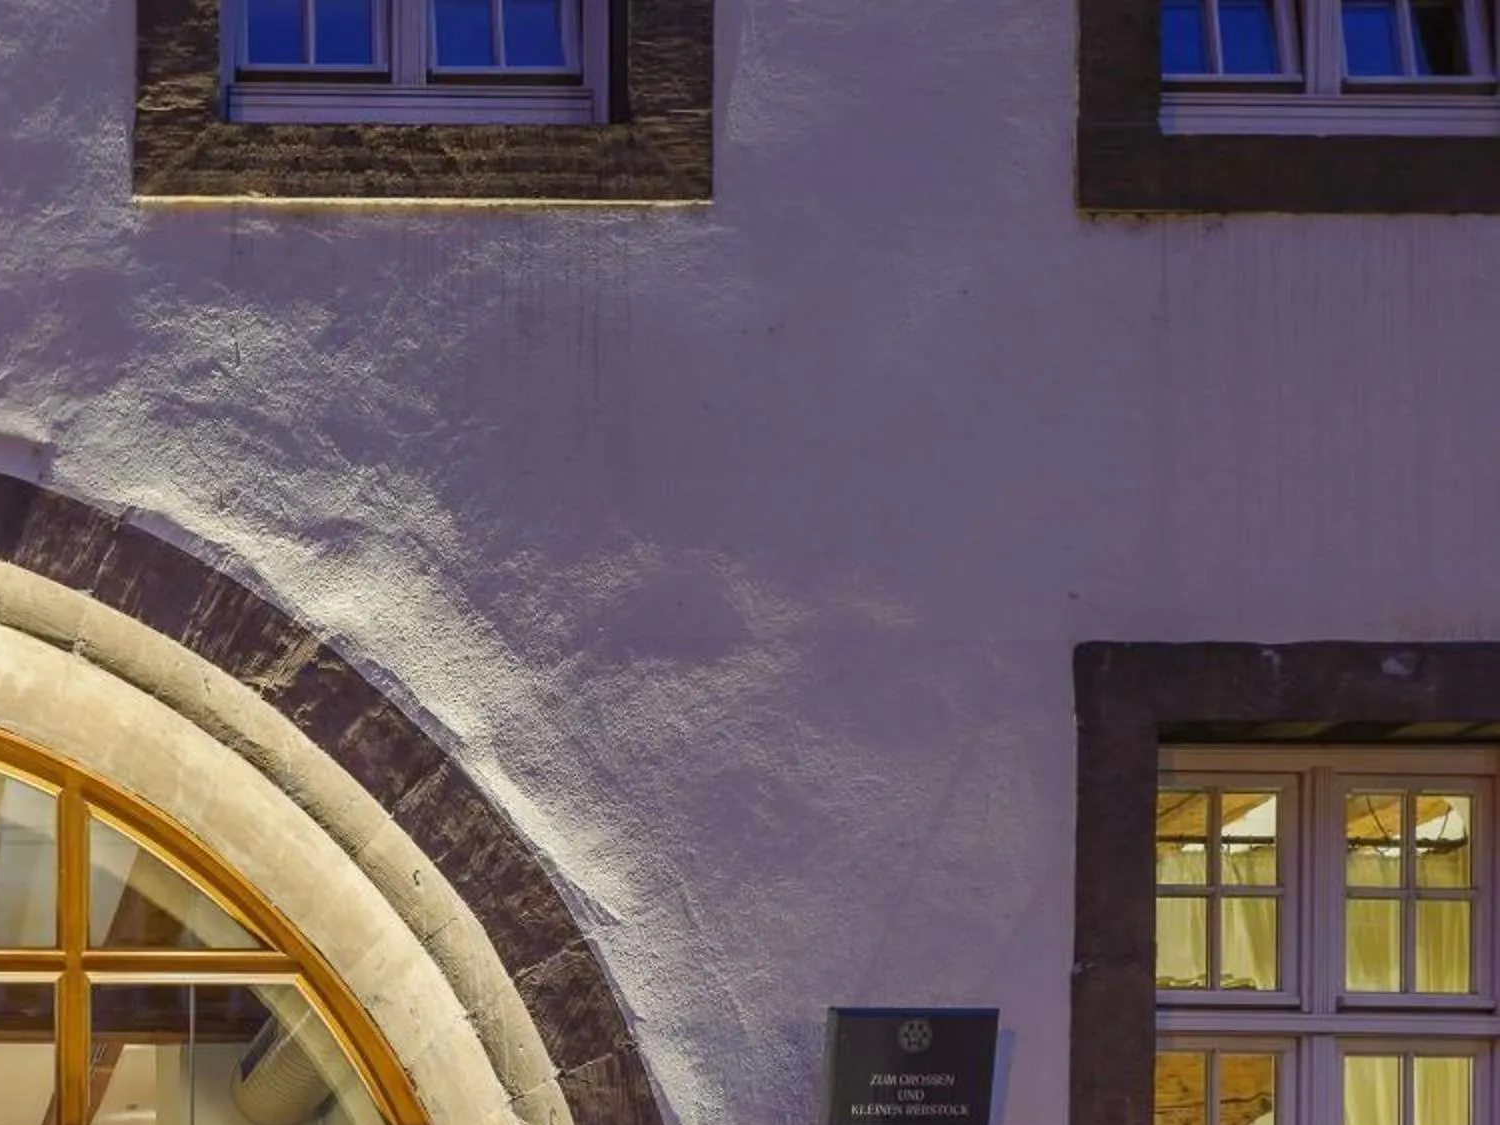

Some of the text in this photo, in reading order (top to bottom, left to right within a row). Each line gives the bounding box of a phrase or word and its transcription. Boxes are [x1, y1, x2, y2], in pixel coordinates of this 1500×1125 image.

[870, 1074, 897, 1087] ZUM
[898, 1089, 925, 1101] UND
[851, 1103, 903, 1116] KLEINEN
